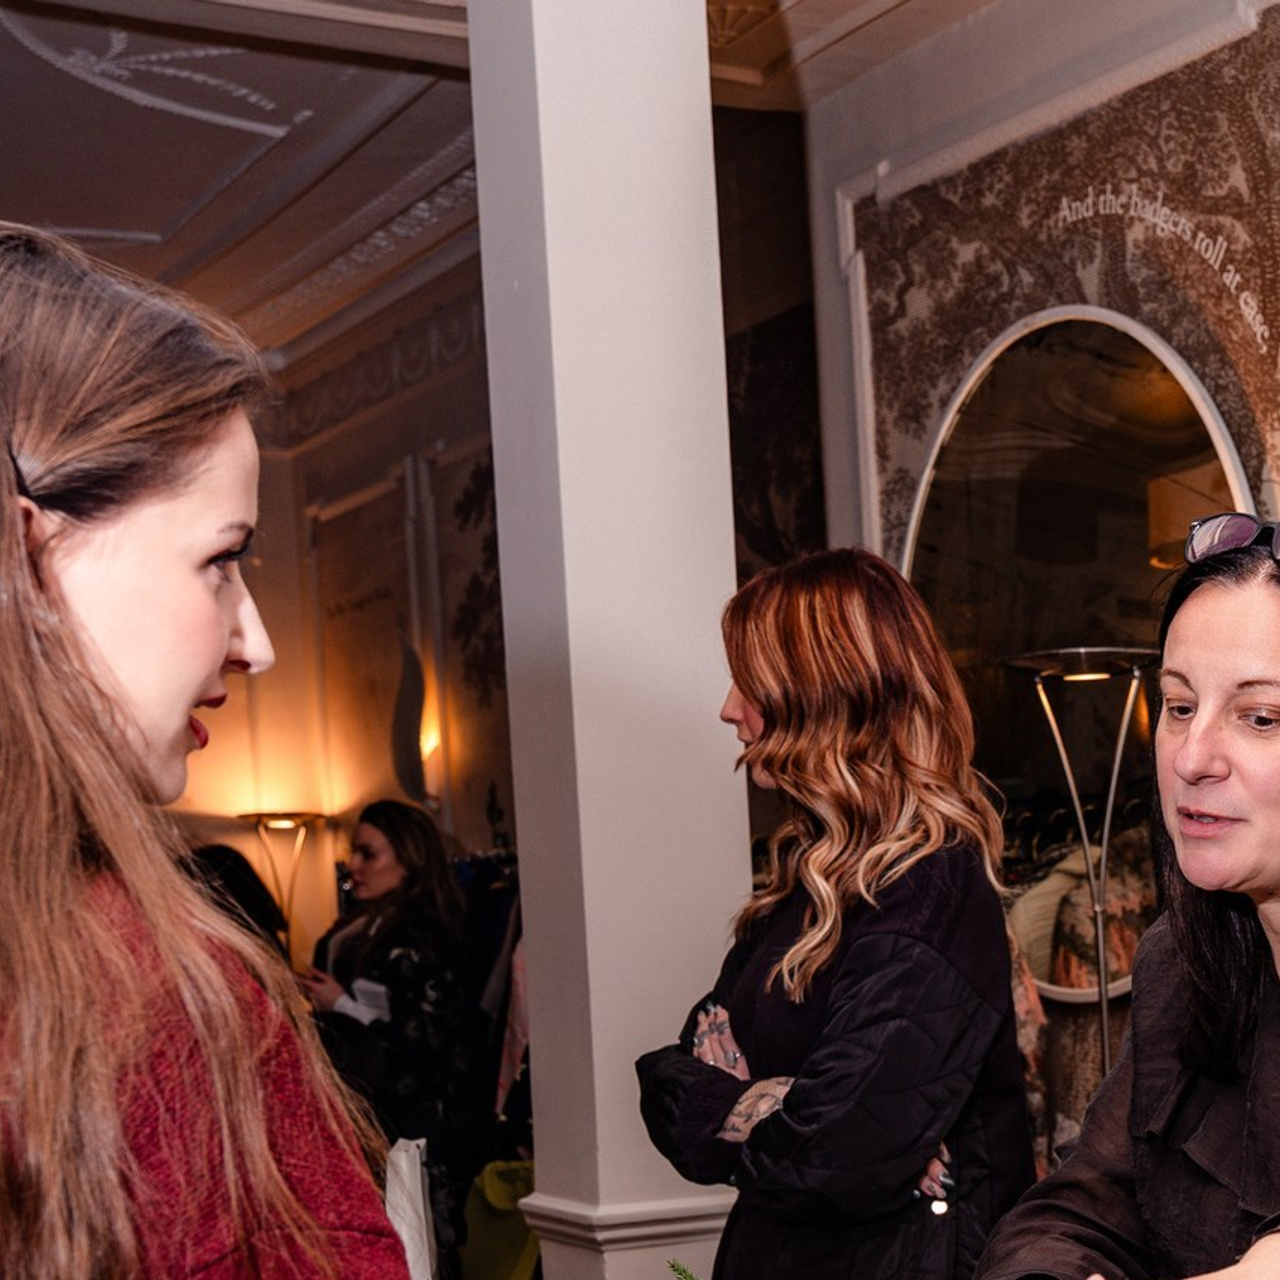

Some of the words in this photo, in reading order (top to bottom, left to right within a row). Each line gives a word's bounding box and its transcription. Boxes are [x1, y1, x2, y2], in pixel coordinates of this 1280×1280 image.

[1057, 185, 1093, 226] And
[1099, 183, 1124, 214] the
[1130, 184, 1194, 240] badgers
[1194, 231, 1228, 270] roll
[1222, 264, 1243, 292] at
[1239, 291, 1269, 354] ease,
